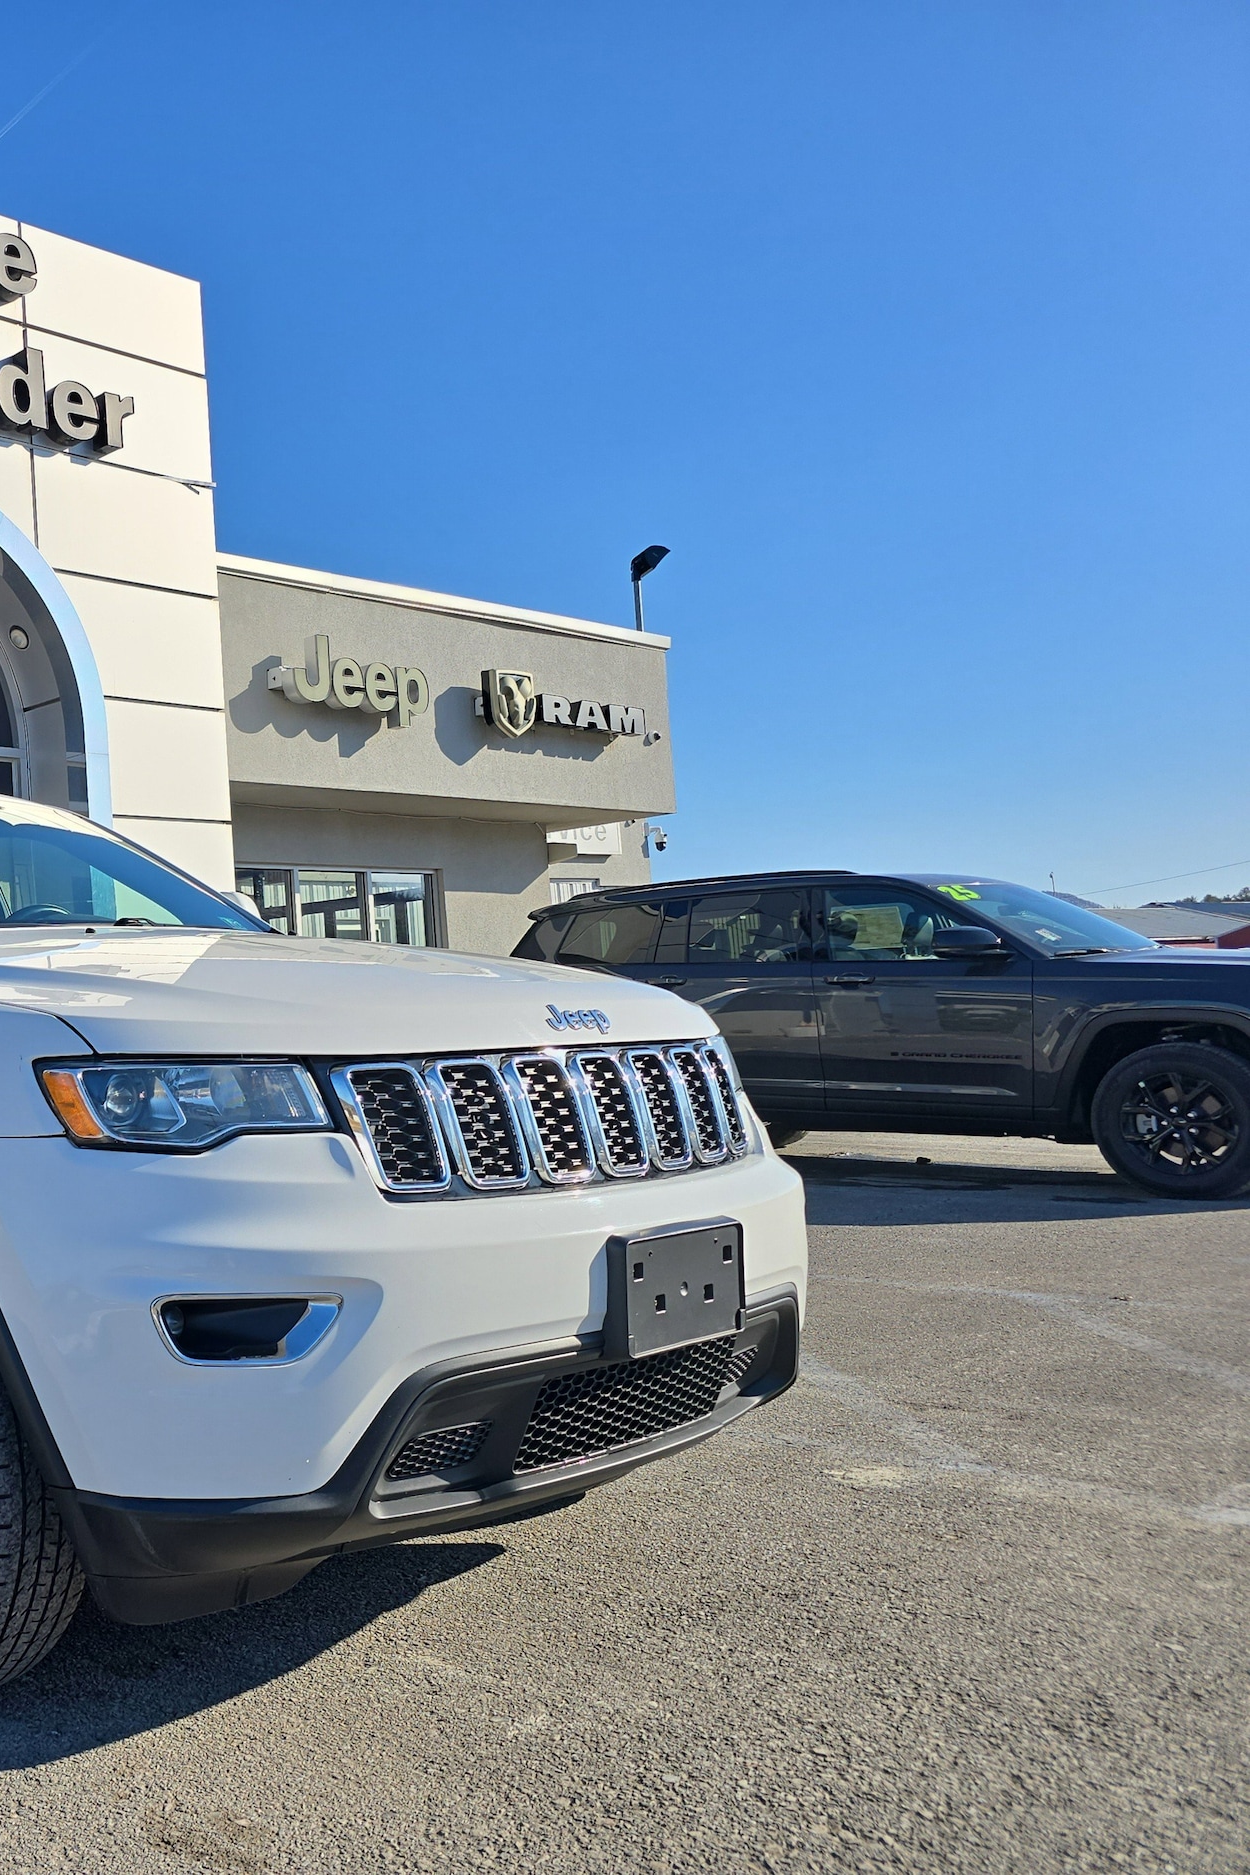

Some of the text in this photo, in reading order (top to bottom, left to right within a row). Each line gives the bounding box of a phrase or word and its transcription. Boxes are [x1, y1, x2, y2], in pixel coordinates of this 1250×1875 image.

[284, 634, 429, 728] Jeep
[540, 693, 645, 736] RAM
[937, 885, 981, 901] 25
[545, 1004, 611, 1034] Jeep
[950, 1052, 1023, 1060] CHEROKEE
